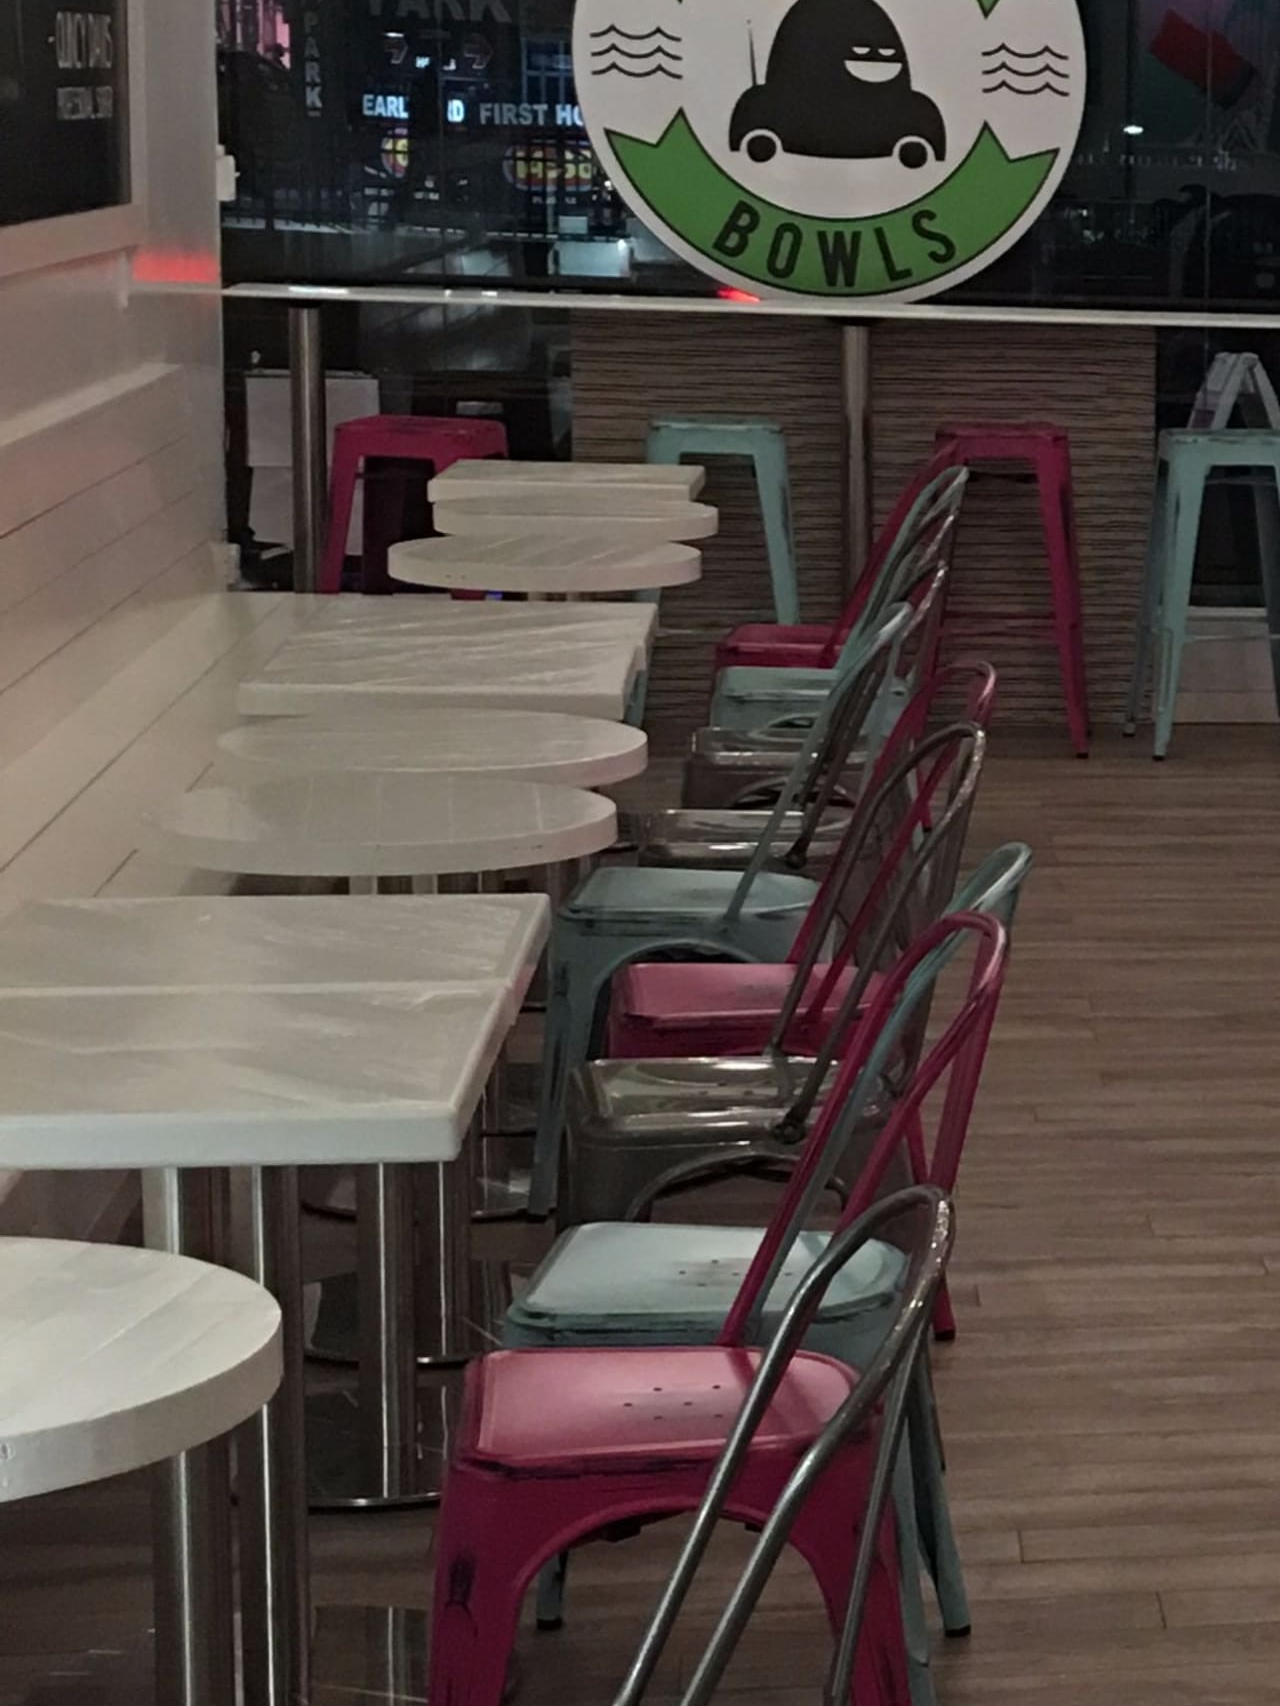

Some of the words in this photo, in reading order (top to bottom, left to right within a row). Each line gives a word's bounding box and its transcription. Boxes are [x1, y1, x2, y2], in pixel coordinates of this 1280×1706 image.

[304, 10, 323, 108] PARK
[362, 94, 409, 120] EARL
[481, 102, 549, 126] FIRST
[712, 199, 957, 288] BOWLS
